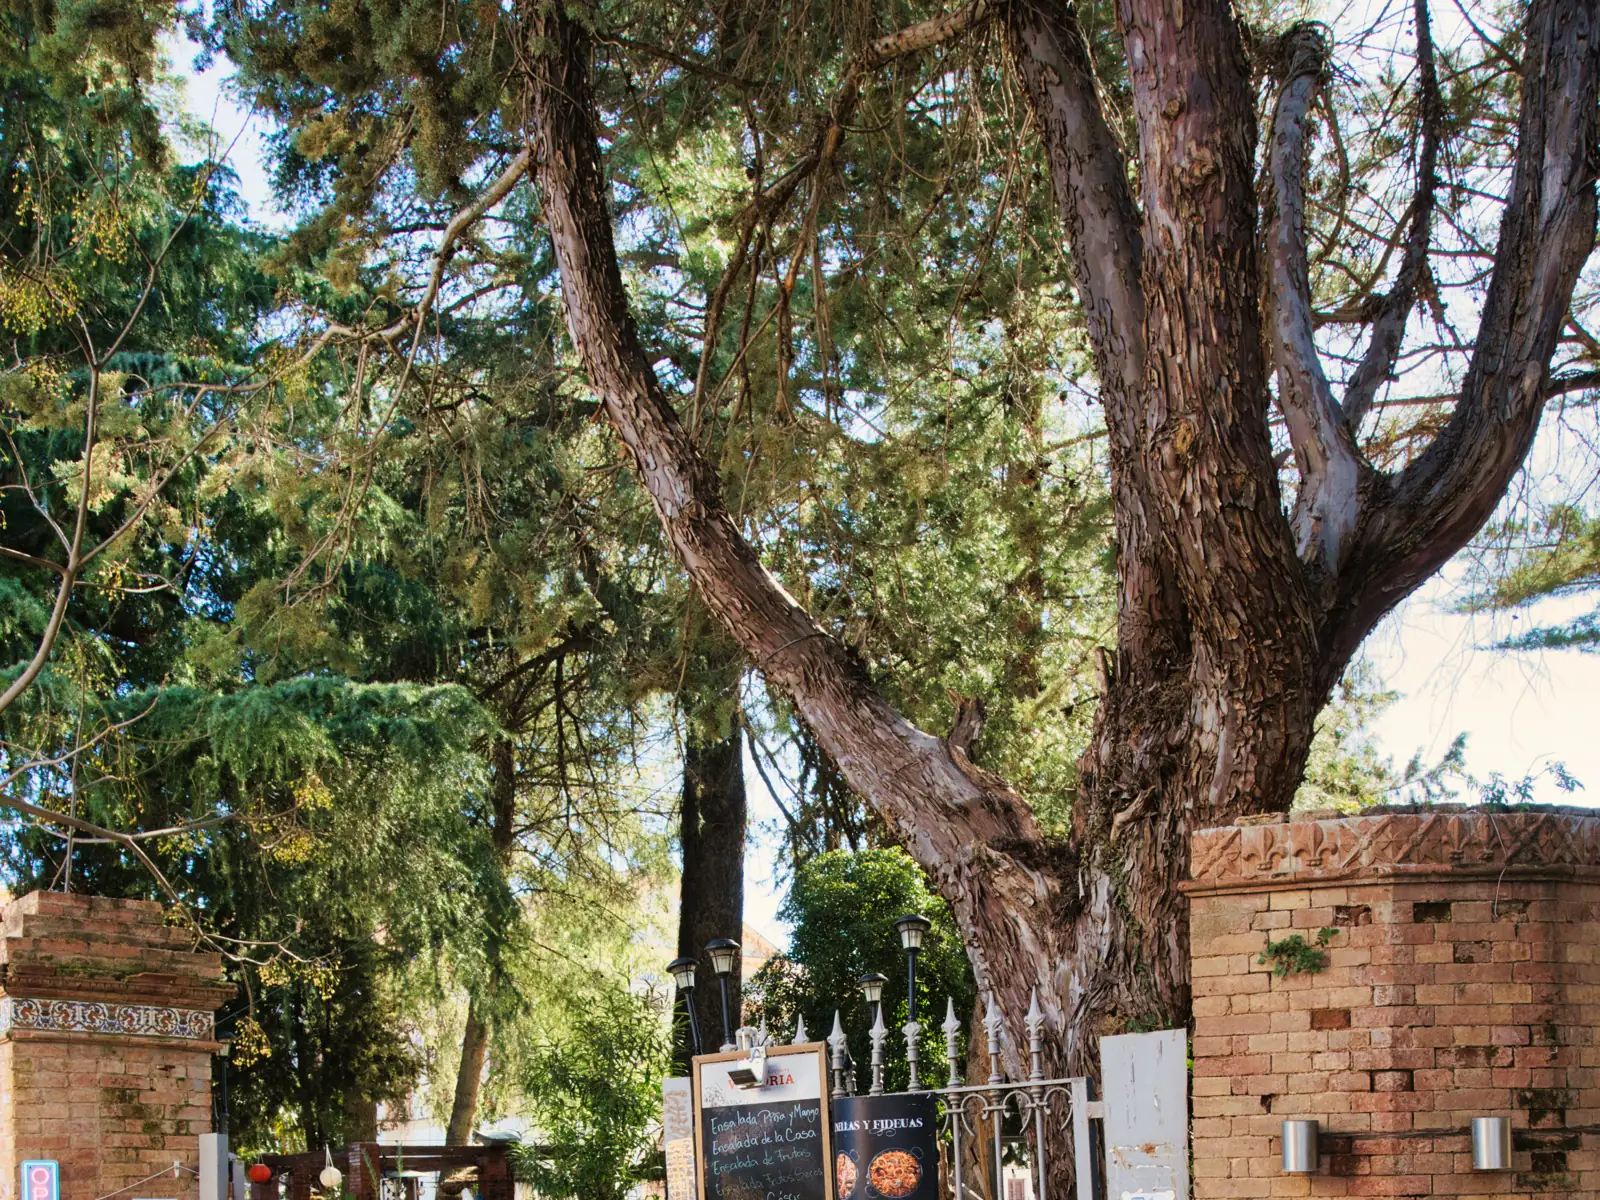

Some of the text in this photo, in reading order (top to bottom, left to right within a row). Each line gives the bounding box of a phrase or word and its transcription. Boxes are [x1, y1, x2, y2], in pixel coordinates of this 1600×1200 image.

[711, 1111, 757, 1134] Ensalada
[793, 1104, 819, 1122] Mango
[863, 1121, 871, 1130] Y
[873, 1118, 923, 1130] FIDEUAS
[712, 1128, 816, 1155] Ensalada de la Casa
[713, 1151, 774, 1175] Ensalada de
